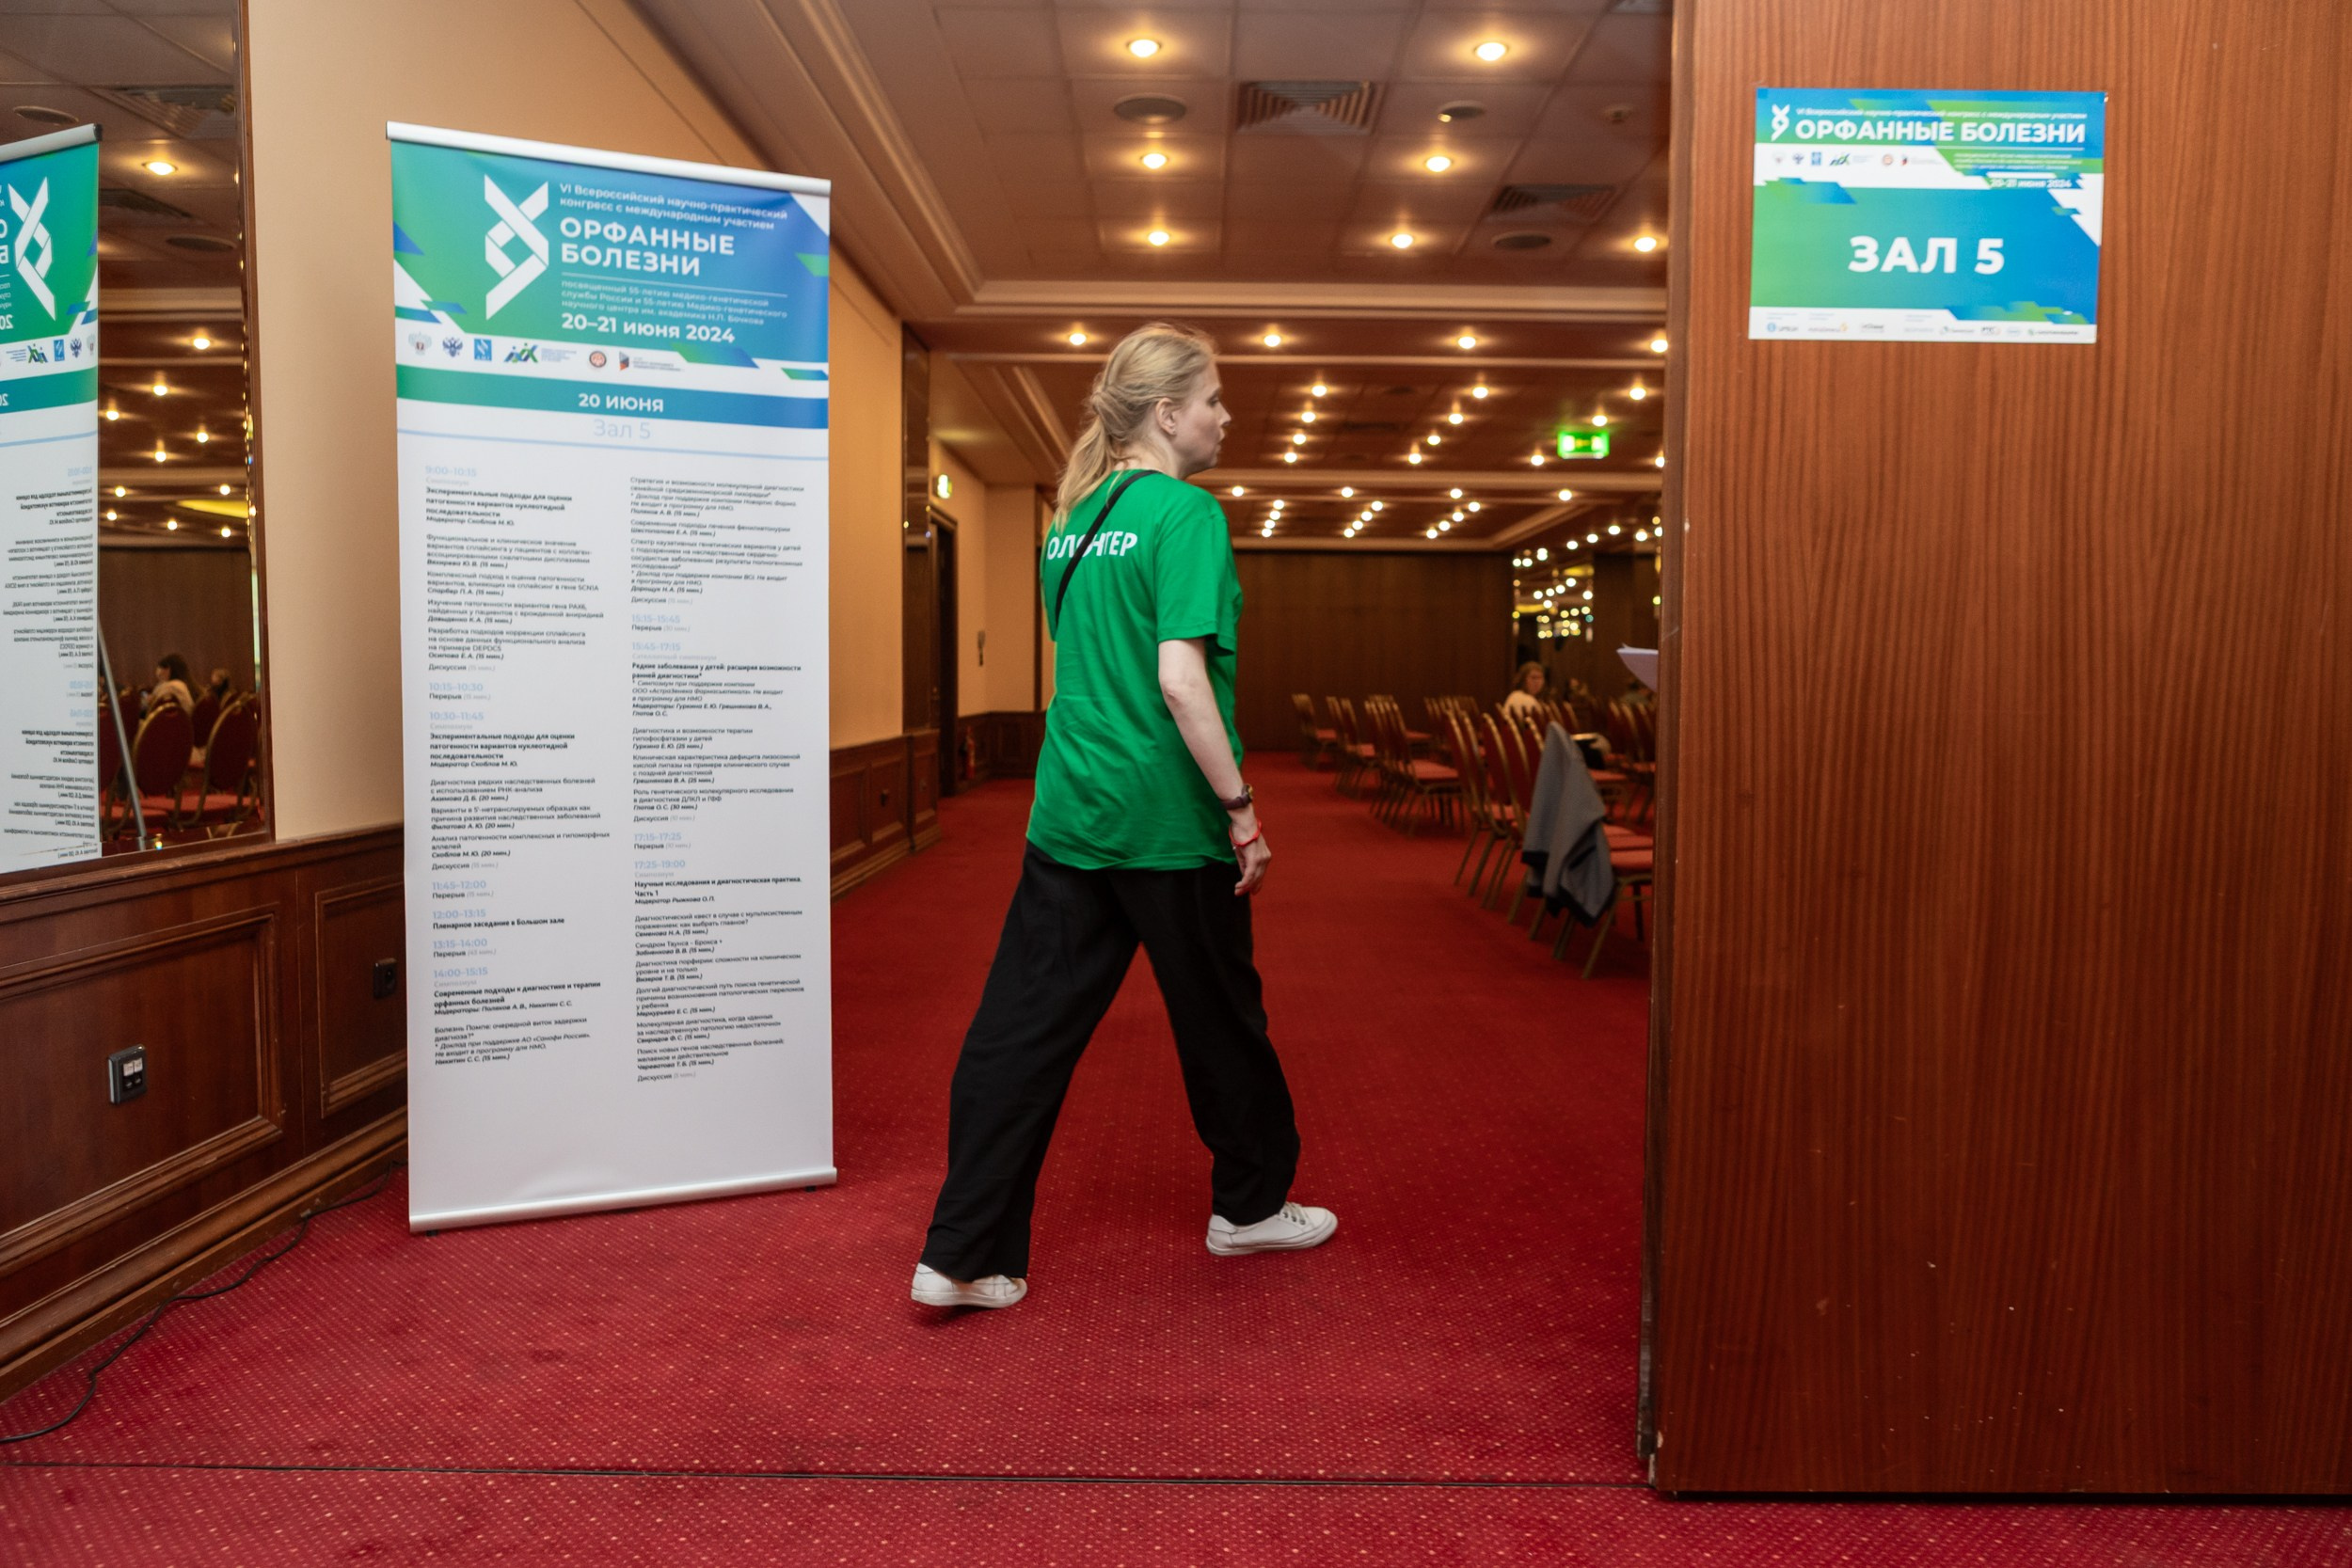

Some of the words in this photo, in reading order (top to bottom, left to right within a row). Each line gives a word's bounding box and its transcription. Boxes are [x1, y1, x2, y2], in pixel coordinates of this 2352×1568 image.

[1795, 119, 1954, 141] ОРФАННЫЕ
[1961, 122, 2085, 143] БОЛЕЗНИ
[560, 183, 571, 192] VI
[574, 185, 664, 203] Всероссийский
[667, 198, 787, 219] научно-практический
[560, 196, 612, 211] конгресс
[615, 203, 622, 212] с
[625, 204, 721, 223] международным
[723, 211, 774, 229] участием
[560, 217, 734, 254] ОРФАННЫЕ
[562, 243, 699, 276] БОЛЕЗНИ
[1849, 236, 1956, 274] ЗАЛ
[1974, 238, 2005, 274] 5
[561, 298, 604, 310] научного
[599, 293, 632, 302] России
[623, 322, 680, 338] июня
[686, 324, 735, 342] 2024
[579, 393, 600, 407] 20
[606, 395, 663, 412] ИЮНЯ
[593, 418, 632, 438] Зал
[639, 421, 651, 439] 5
[1047, 531, 1138, 560] ОЛОНТЕР
[631, 596, 666, 604] Дискуссия
[632, 672, 656, 680] ранней
[430, 732, 502, 741] Экспериментальные
[632, 735, 687, 743] гипофосфатазии
[518, 742, 568, 751] нуклеотидной
[634, 881, 664, 889] Научные
[434, 989, 482, 998] Современные
[522, 984, 565, 993] диагностике
[434, 1000, 470, 1009] орфанных
[471, 996, 505, 1005] болезней
[493, 1020, 531, 1029] очередной
[637, 1073, 672, 1082] Дискуссия
